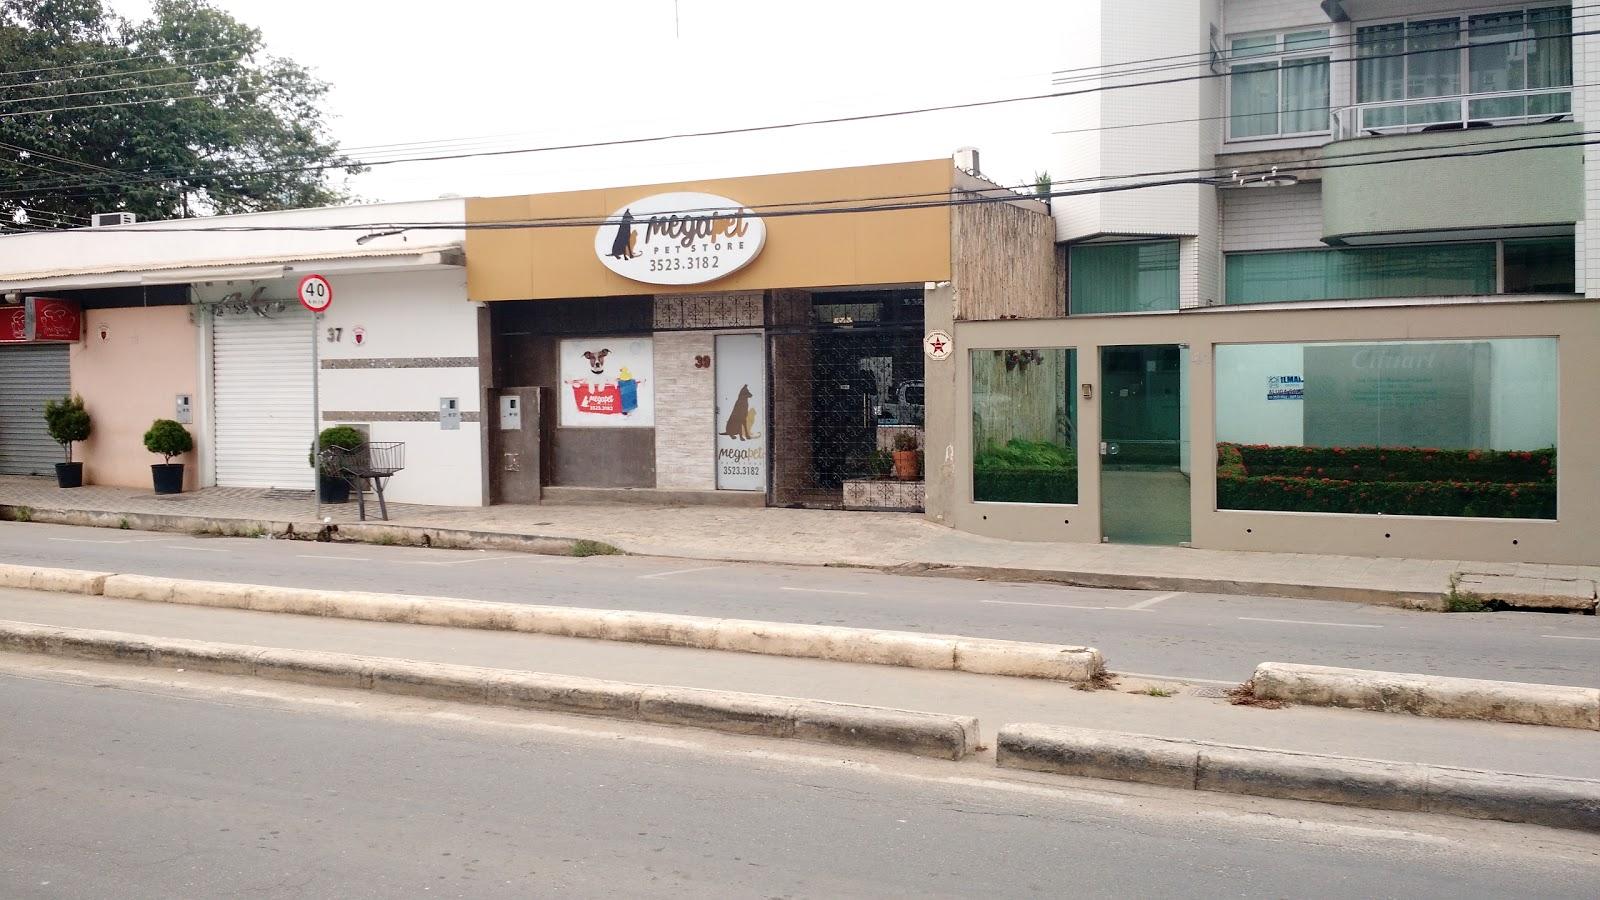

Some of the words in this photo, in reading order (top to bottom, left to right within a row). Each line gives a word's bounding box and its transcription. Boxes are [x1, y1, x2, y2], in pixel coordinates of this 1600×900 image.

[653, 245, 683, 255] PET
[691, 241, 745, 252] STORE
[650, 255, 719, 272] 3523.3182
[305, 282, 325, 297] 40
[326, 327, 344, 343] 37
[718, 446, 763, 463] megapet
[723, 466, 760, 476] 3523.3182
